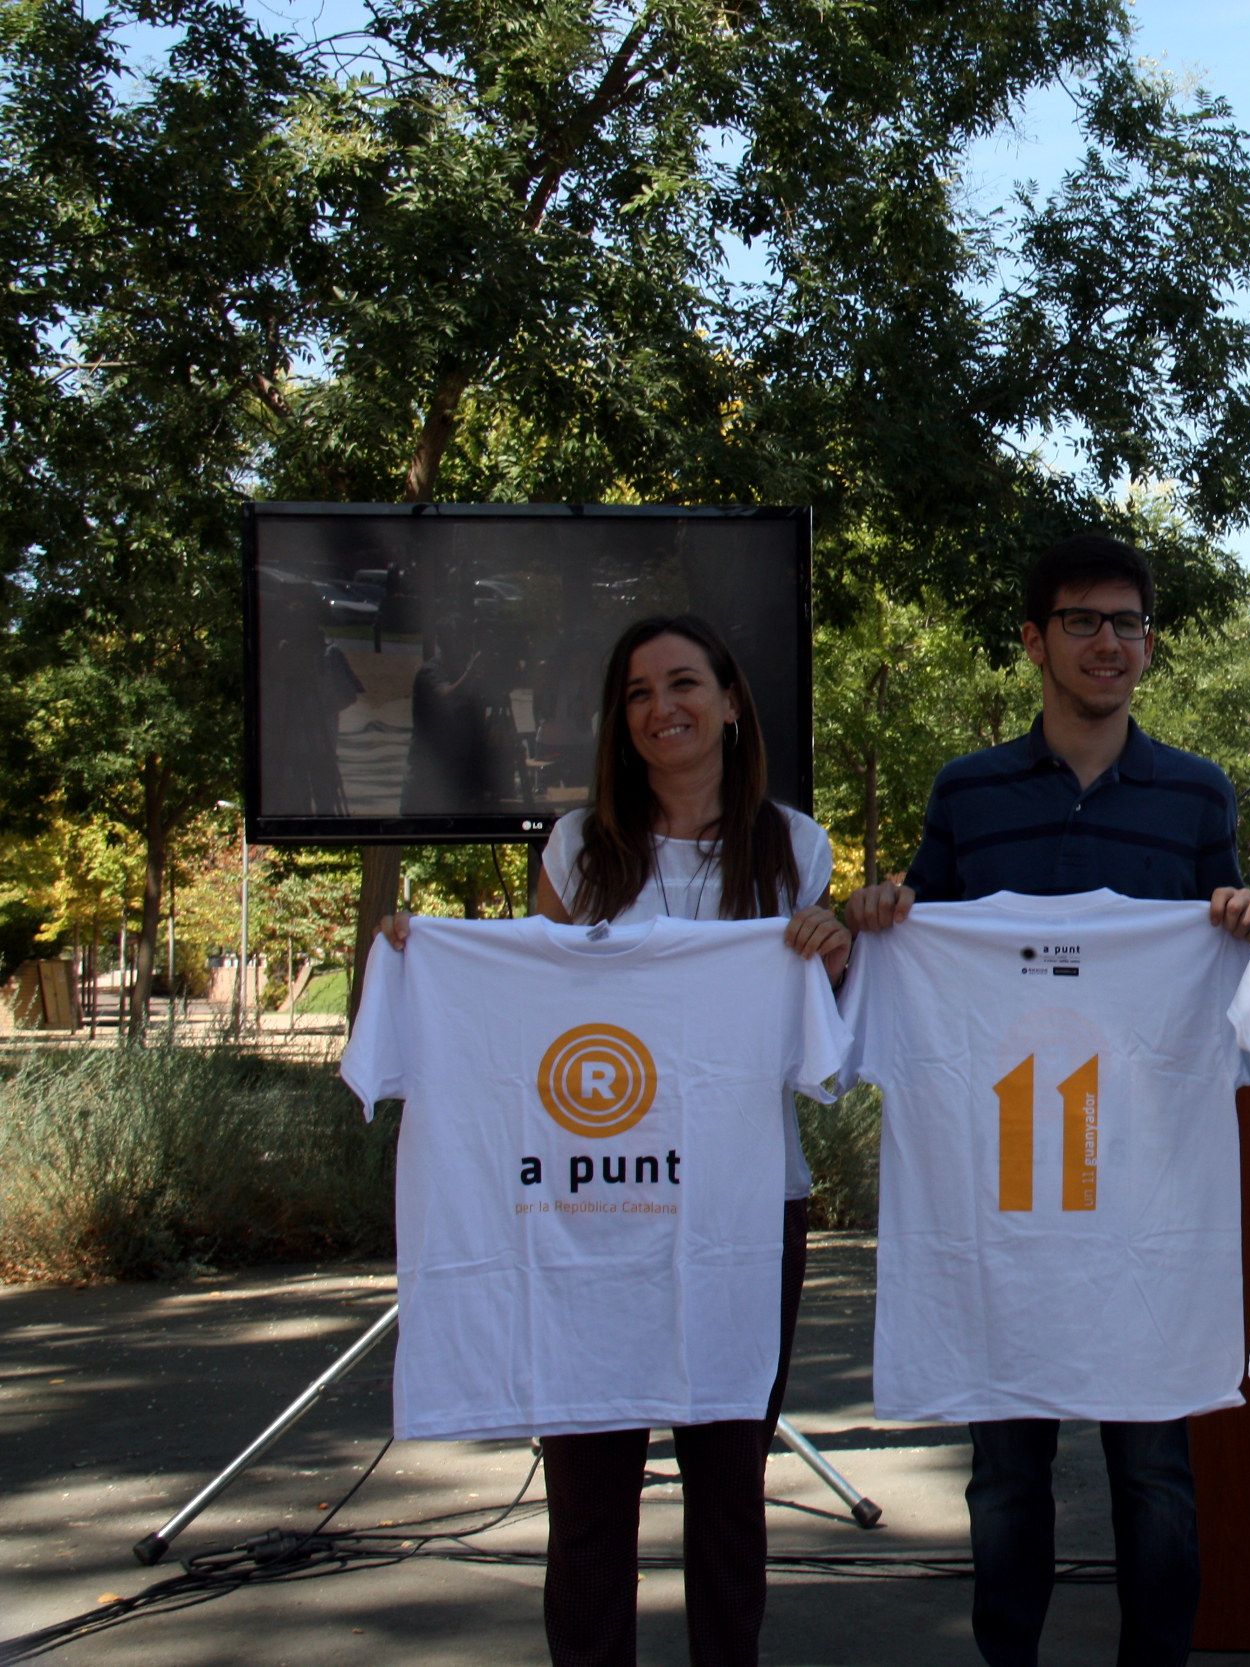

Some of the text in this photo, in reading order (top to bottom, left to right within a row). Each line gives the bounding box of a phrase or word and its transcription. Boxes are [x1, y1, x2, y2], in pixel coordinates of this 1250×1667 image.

[532, 821, 543, 830] LG
[1054, 945, 1080, 955] punt
[580, 1061, 617, 1099] R
[992, 1053, 1098, 1211] 11
[1082, 1092, 1098, 1166] guanyador
[520, 1149, 681, 1193] a punt
[515, 1201, 678, 1216] per la República Catalana
